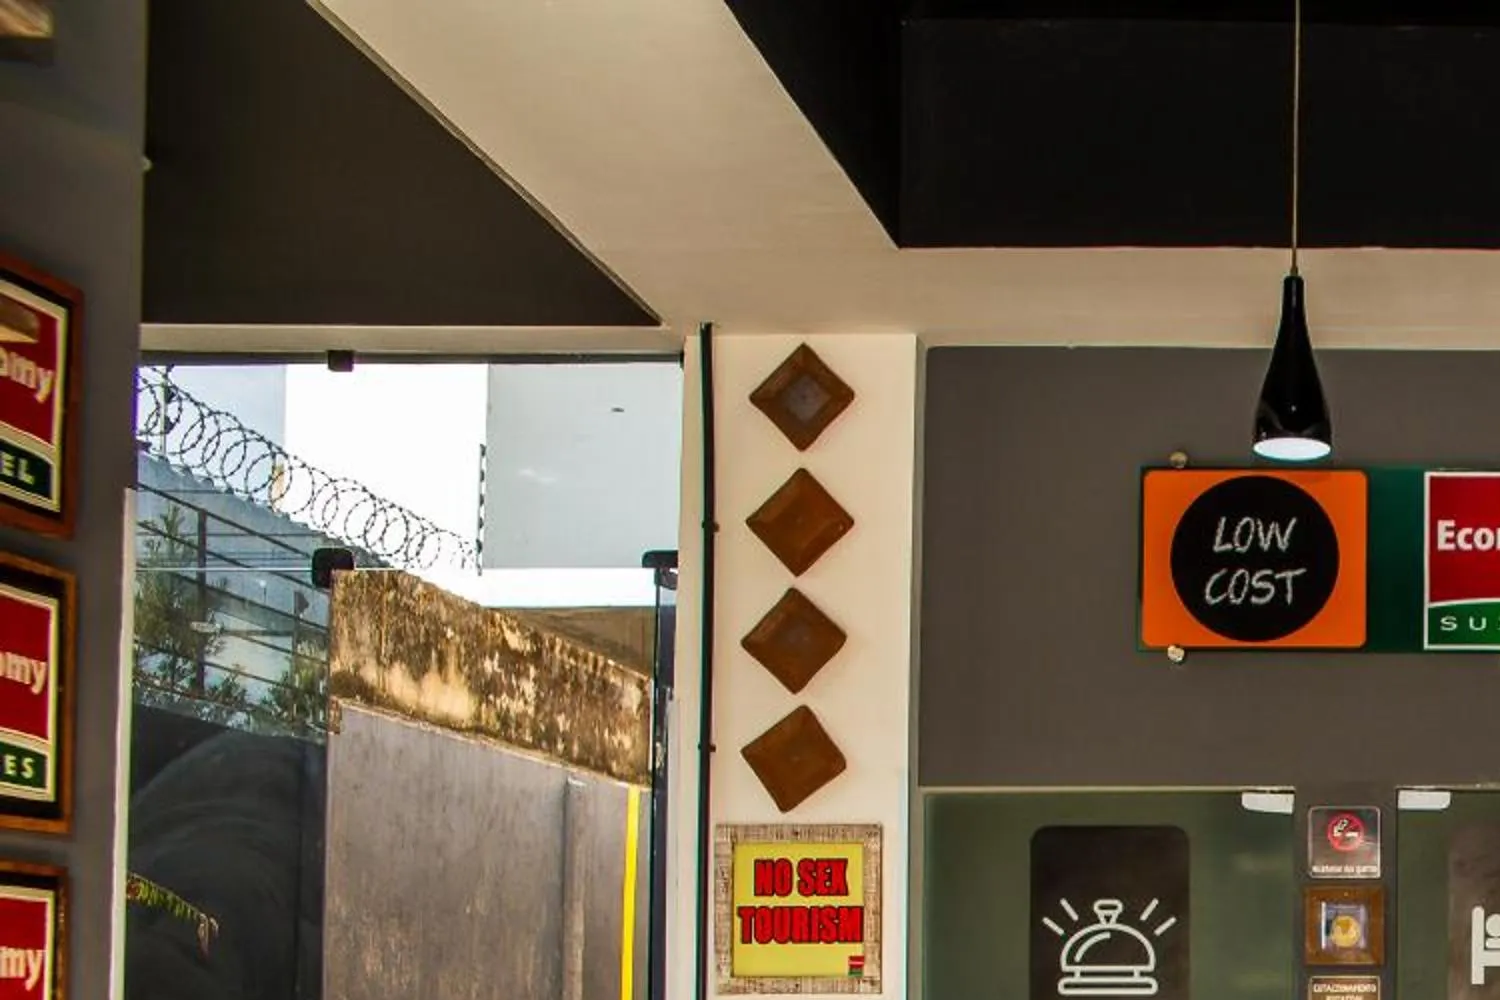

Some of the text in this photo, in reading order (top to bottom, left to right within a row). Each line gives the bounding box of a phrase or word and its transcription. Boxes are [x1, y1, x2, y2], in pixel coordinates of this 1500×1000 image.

[1213, 515, 1297, 553] LOW
[1204, 568, 1307, 605] COST
[753, 858, 849, 897] NO SEX
[737, 905, 865, 944] TOURISM
